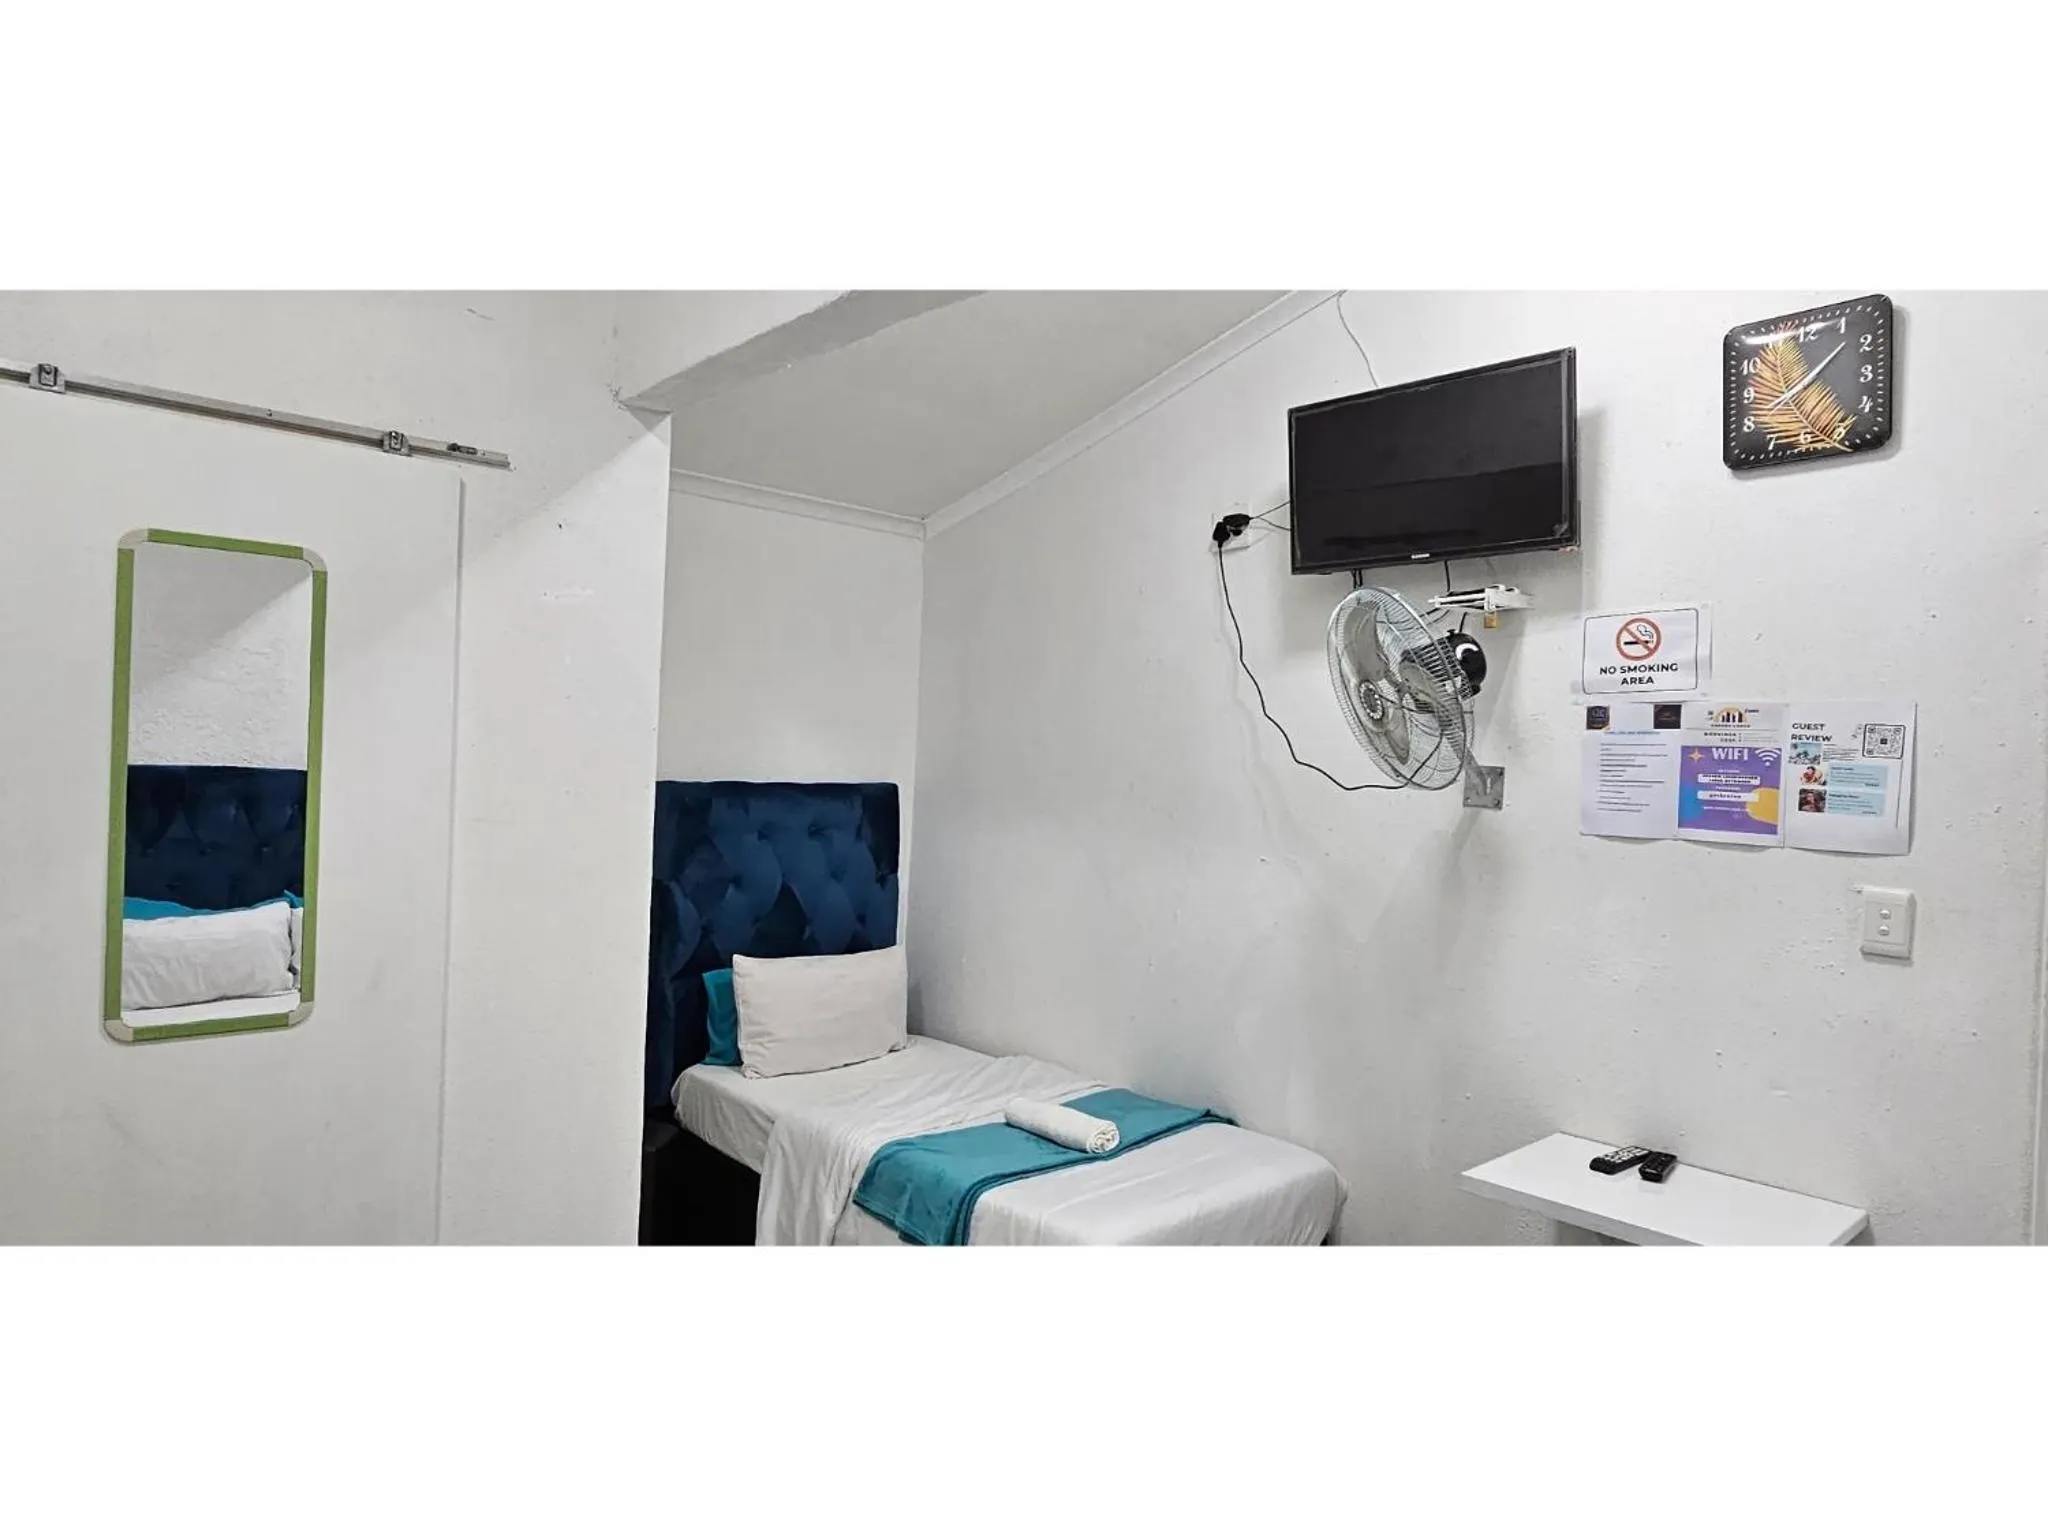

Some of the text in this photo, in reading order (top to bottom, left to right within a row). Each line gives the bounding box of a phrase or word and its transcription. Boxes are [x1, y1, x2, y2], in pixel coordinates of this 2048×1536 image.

[1837, 316, 1847, 333] 1
[1799, 325, 1818, 342] 12
[1859, 334, 1873, 352] 2
[1740, 357, 1760, 375] 10
[1860, 364, 1873, 382] 3
[1743, 388, 1755, 404] 9
[1858, 396, 1873, 412] 4
[1743, 416, 1755, 432] 8
[1766, 434, 1777, 450] 7
[1800, 429, 1812, 444] 6
[1599, 663, 1679, 675] NO SMOKING
[1621, 676, 1655, 685] AREA
[1792, 723, 1825, 731] GUEST
[1791, 734, 1833, 742] REVIEW
[1712, 747, 1749, 761] WIFI
